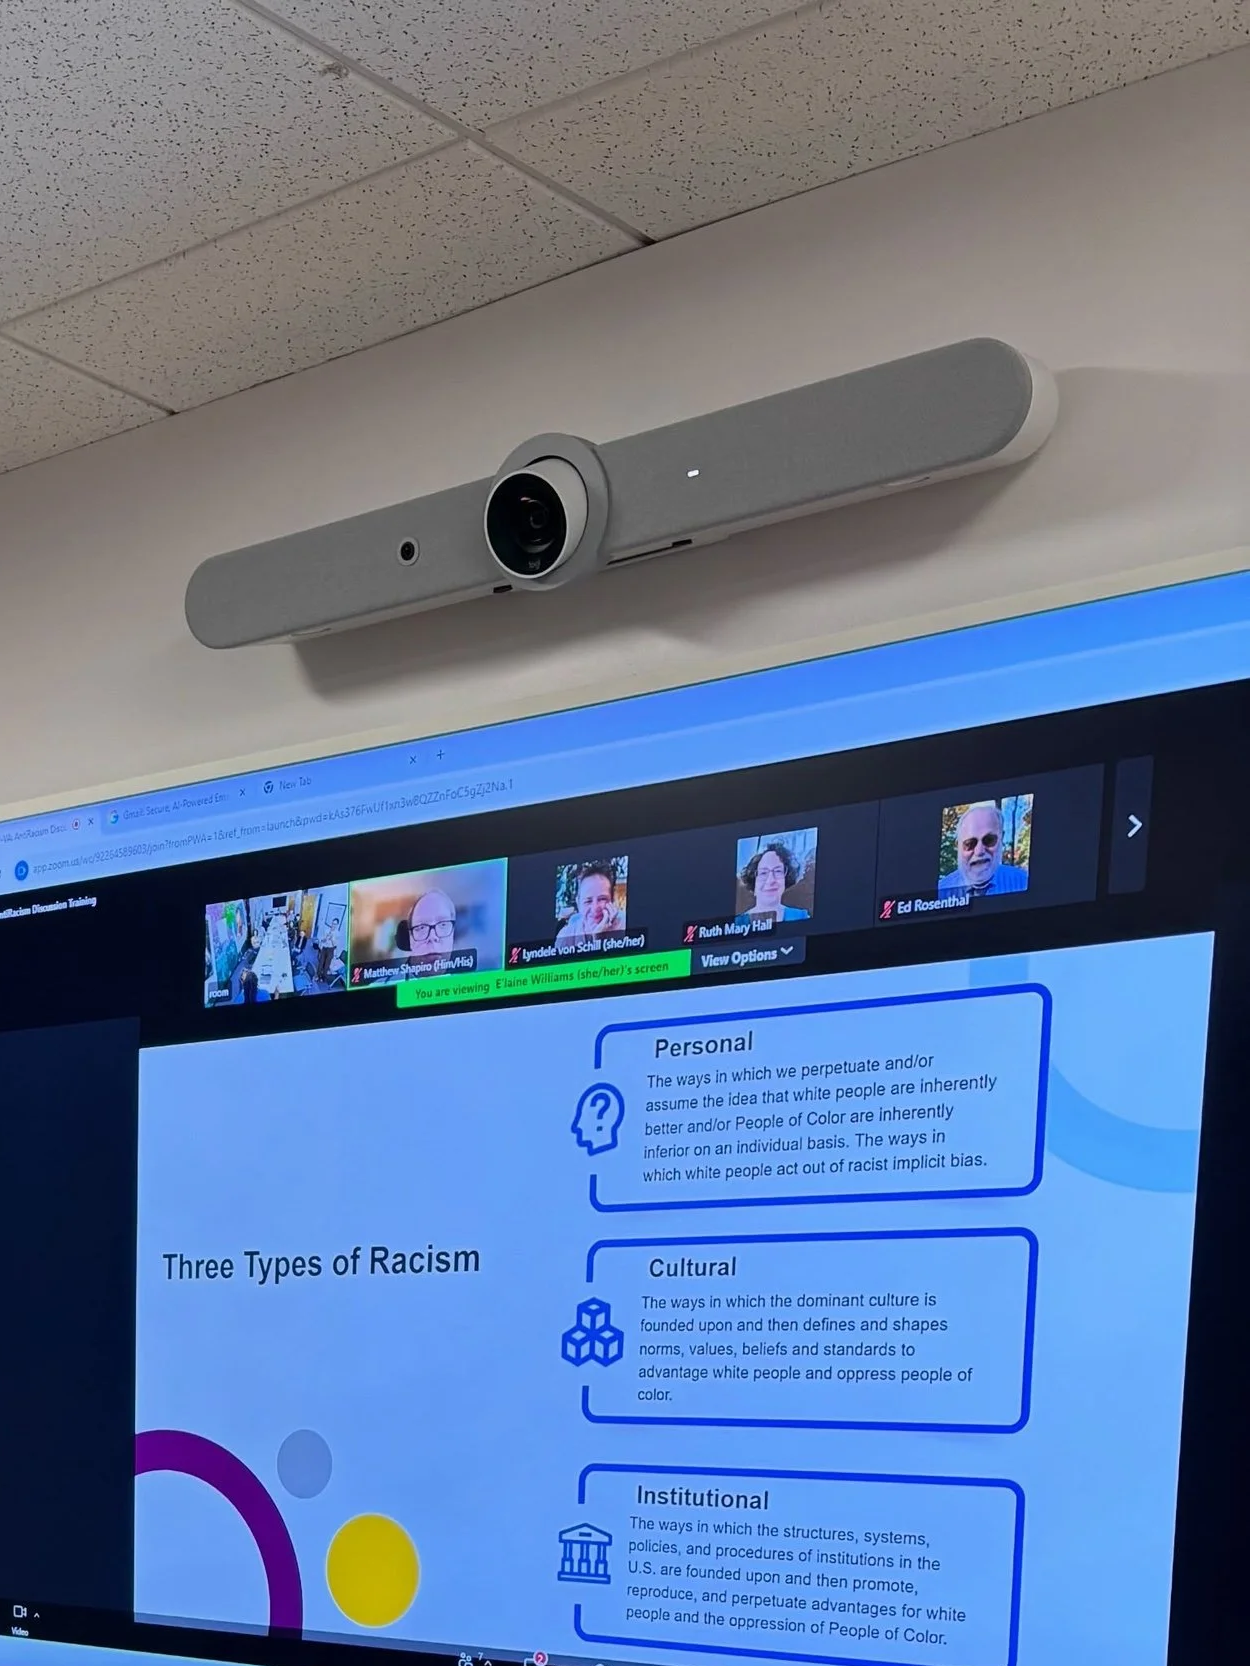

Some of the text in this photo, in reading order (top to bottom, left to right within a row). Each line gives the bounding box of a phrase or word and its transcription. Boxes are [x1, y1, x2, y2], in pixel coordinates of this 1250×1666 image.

[68, 896, 97, 908] Training
[897, 893, 970, 914] Ed Rosenthal
[698, 918, 773, 939] Ruth Mary Hall
[557, 945, 576, 956] von
[577, 940, 601, 954] Schill
[603, 934, 645, 952] (she/her)
[363, 955, 474, 979] Matthew Shapiro (Him/His)
[701, 949, 778, 968] View Options
[209, 988, 229, 999] room
[415, 962, 669, 1000] You are viewing E'laine Williams (she/her)'s screen
[655, 1030, 753, 1059] Personal
[646, 1053, 935, 1089] The ways in which we perpetuate and/or
[645, 1074, 998, 1113] assume the idea that white people are inherently
[644, 1103, 954, 1136] better and/or People of Color are inherently
[643, 1128, 946, 1160] inferior on an individual basis. The ways in
[642, 1152, 987, 1183] which white people act out of racist implicit bias.
[162, 1243, 480, 1286] Three Types of Racism
[649, 1256, 737, 1278] Cultural
[641, 1292, 937, 1312] The ways in which the dominant culture is
[640, 1316, 948, 1335] founded upon and then defines and shapes
[639, 1341, 916, 1358] norms, values, beliefs and standards to
[638, 1364, 974, 1385] advantage white people and oppress people of
[637, 1387, 673, 1401] color.
[637, 1484, 769, 1511] Institutional
[629, 1515, 930, 1549] The ways in which the structures, systems,
[628, 1538, 941, 1571] policies, and procedures of institutions in the
[628, 1560, 918, 1596] U.S. are founded upon and then promote,
[627, 1585, 967, 1623] reproduce, and perpetuate advantages for white
[11, 1626, 29, 1637] Video
[626, 1607, 947, 1646] people and the oppression of People of Color.
